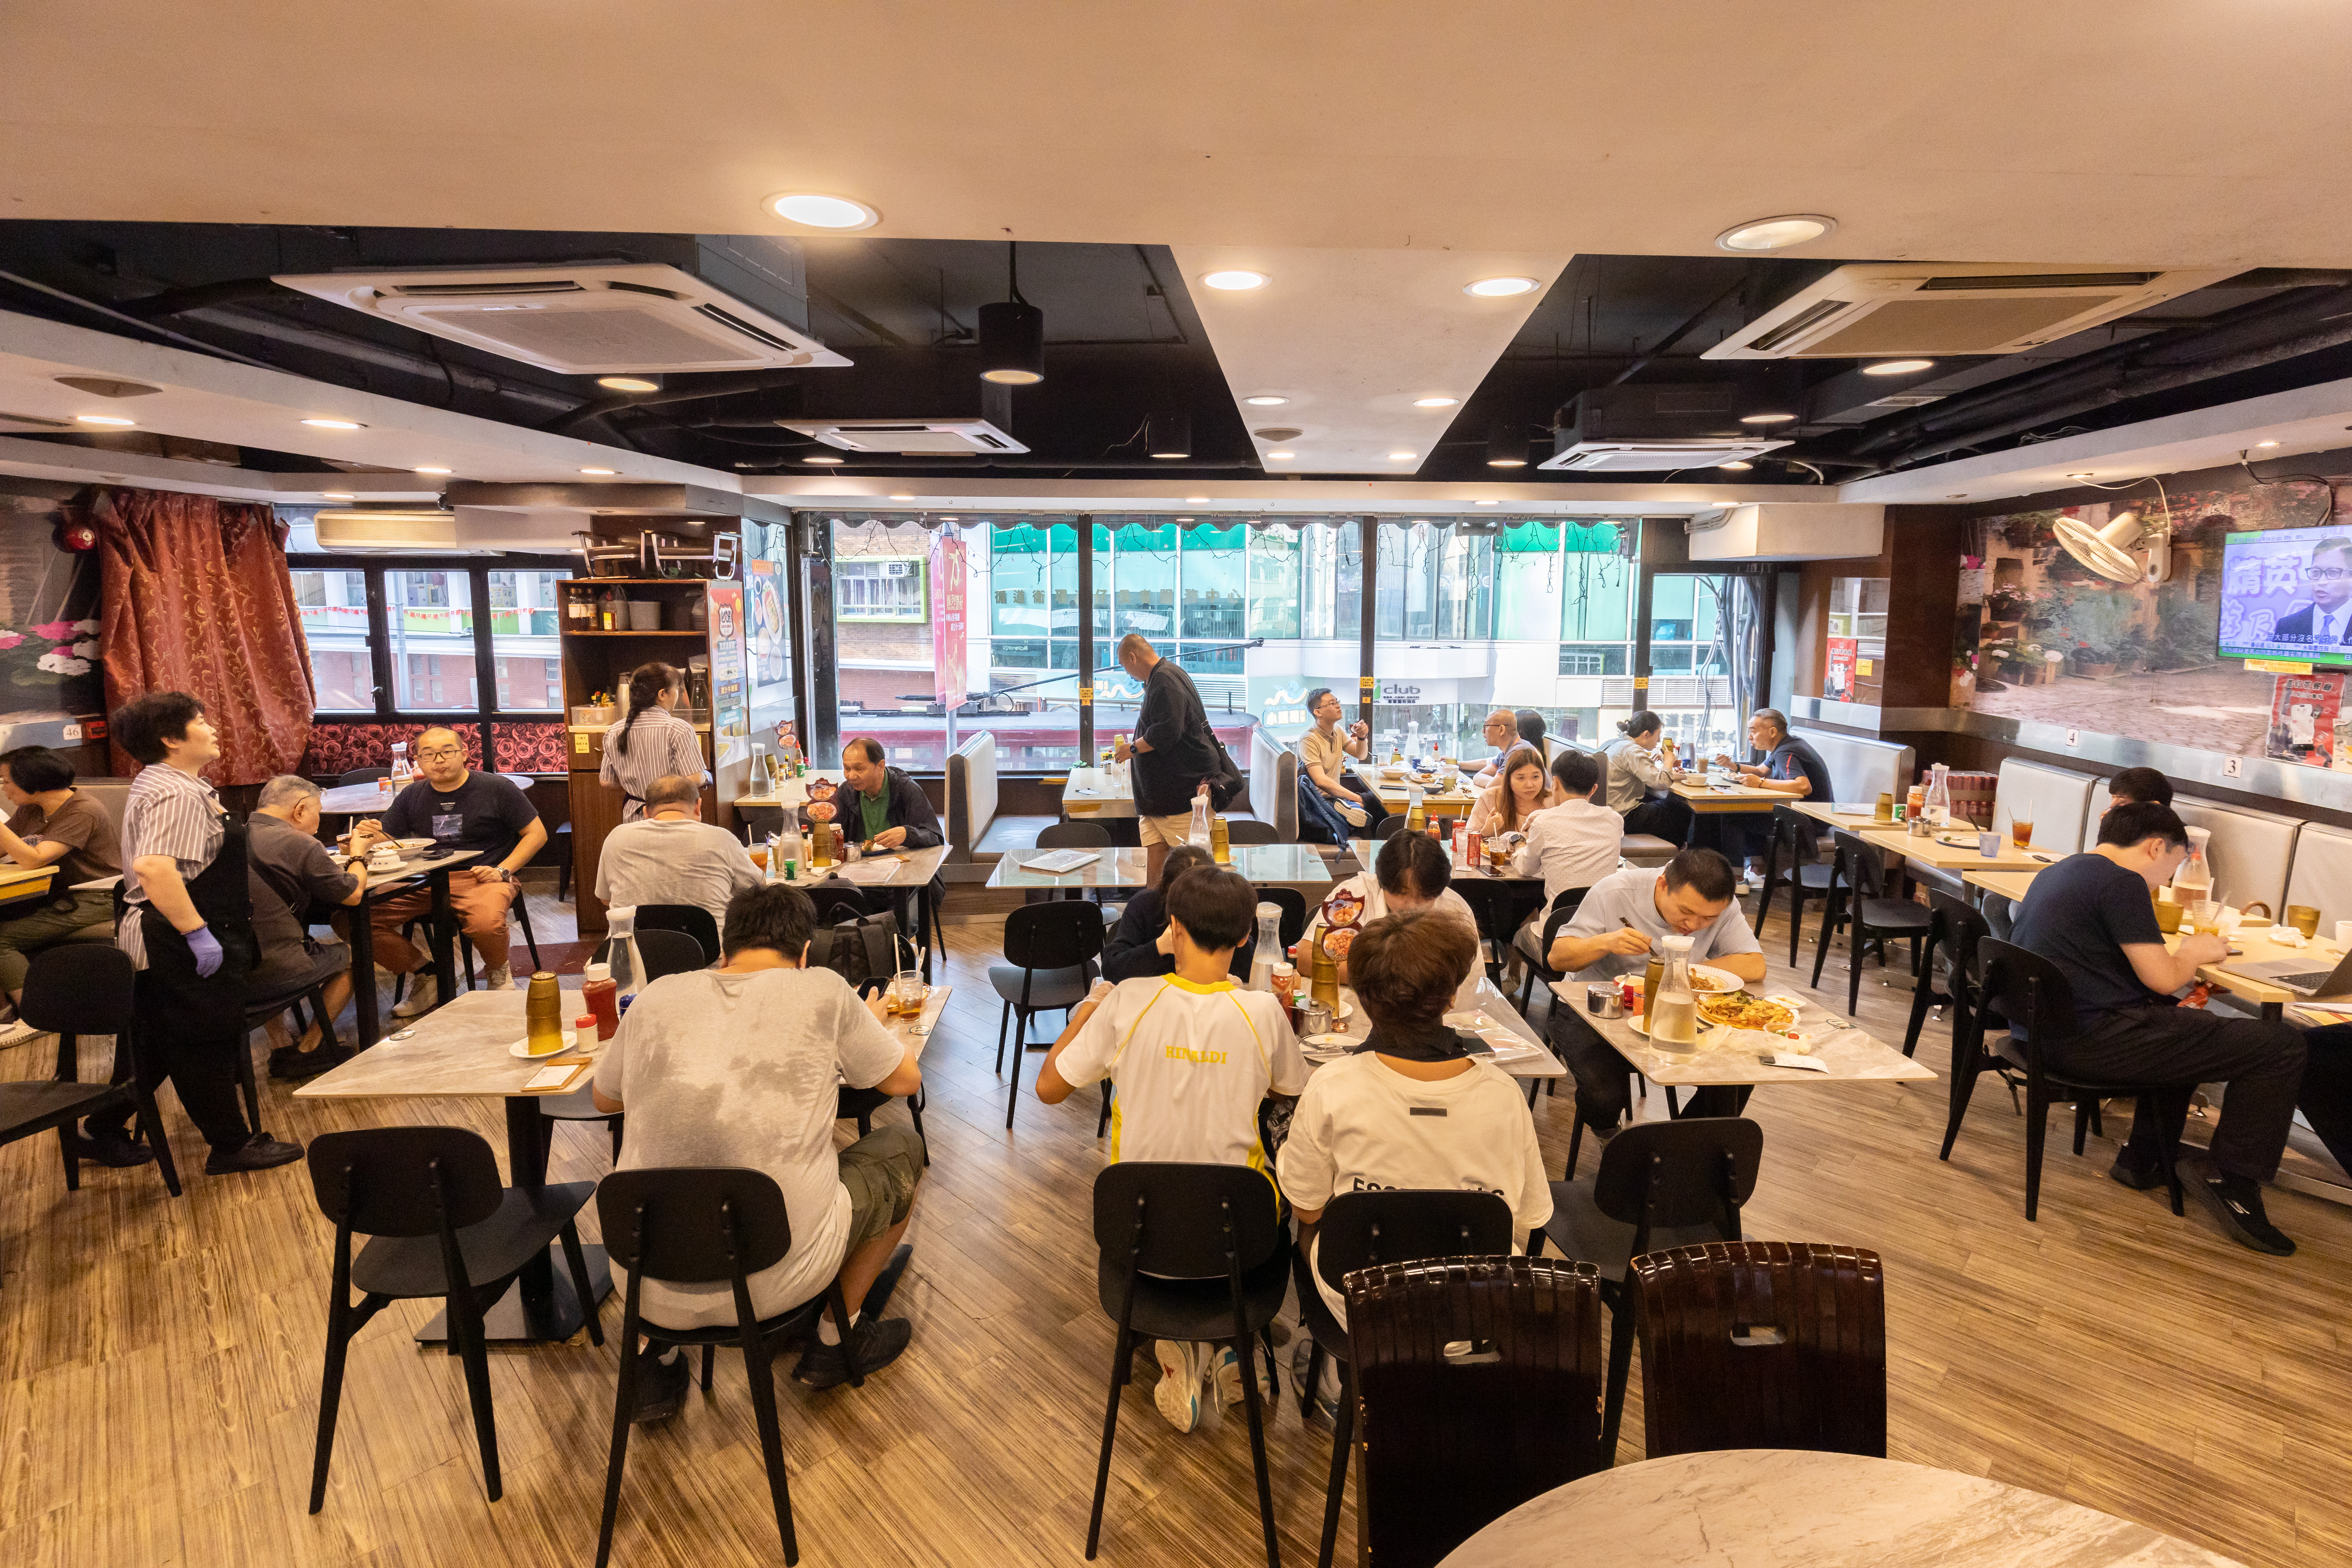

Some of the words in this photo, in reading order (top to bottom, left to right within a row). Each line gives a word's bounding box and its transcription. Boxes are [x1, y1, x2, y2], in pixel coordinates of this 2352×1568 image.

[946, 594, 963, 610] 熱烈慶祝
[995, 588, 1241, 604] 循道衛理仔長者服務中心
[66, 728, 79, 737] 46
[2070, 732, 2075, 743] 4
[2228, 760, 2236, 773] 3
[1165, 1045, 1228, 1064] RINALDI
